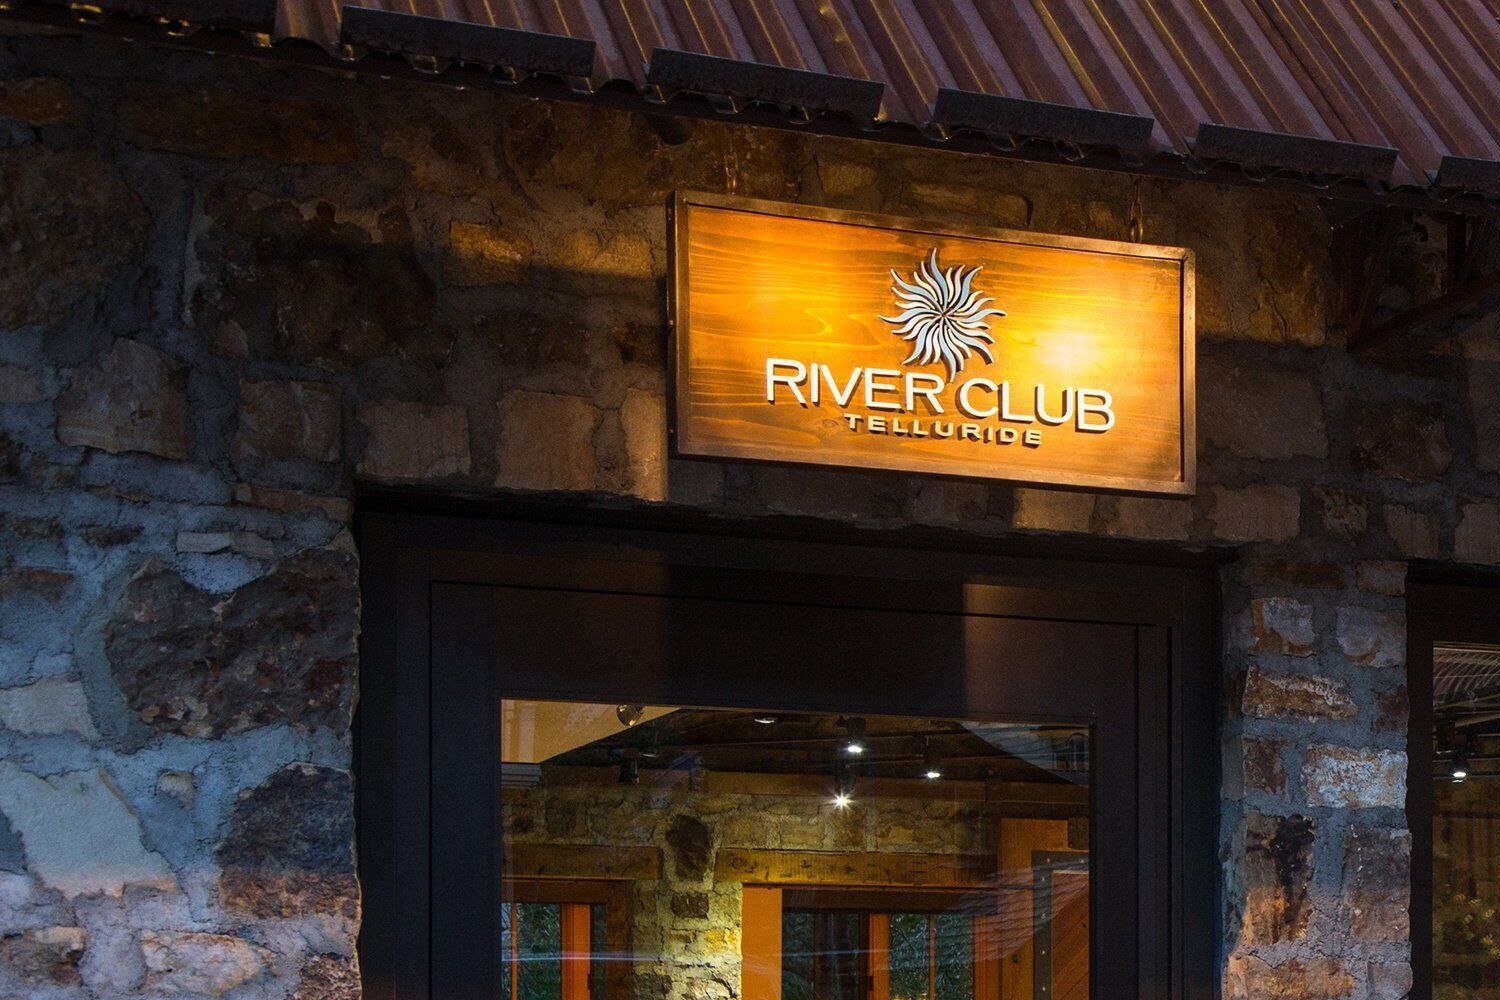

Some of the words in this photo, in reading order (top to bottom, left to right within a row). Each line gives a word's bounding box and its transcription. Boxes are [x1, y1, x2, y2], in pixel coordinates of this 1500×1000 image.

[765, 357, 946, 414] RIVER
[957, 377, 1116, 432] CLUB
[844, 413, 1043, 445] TELLURIDE
